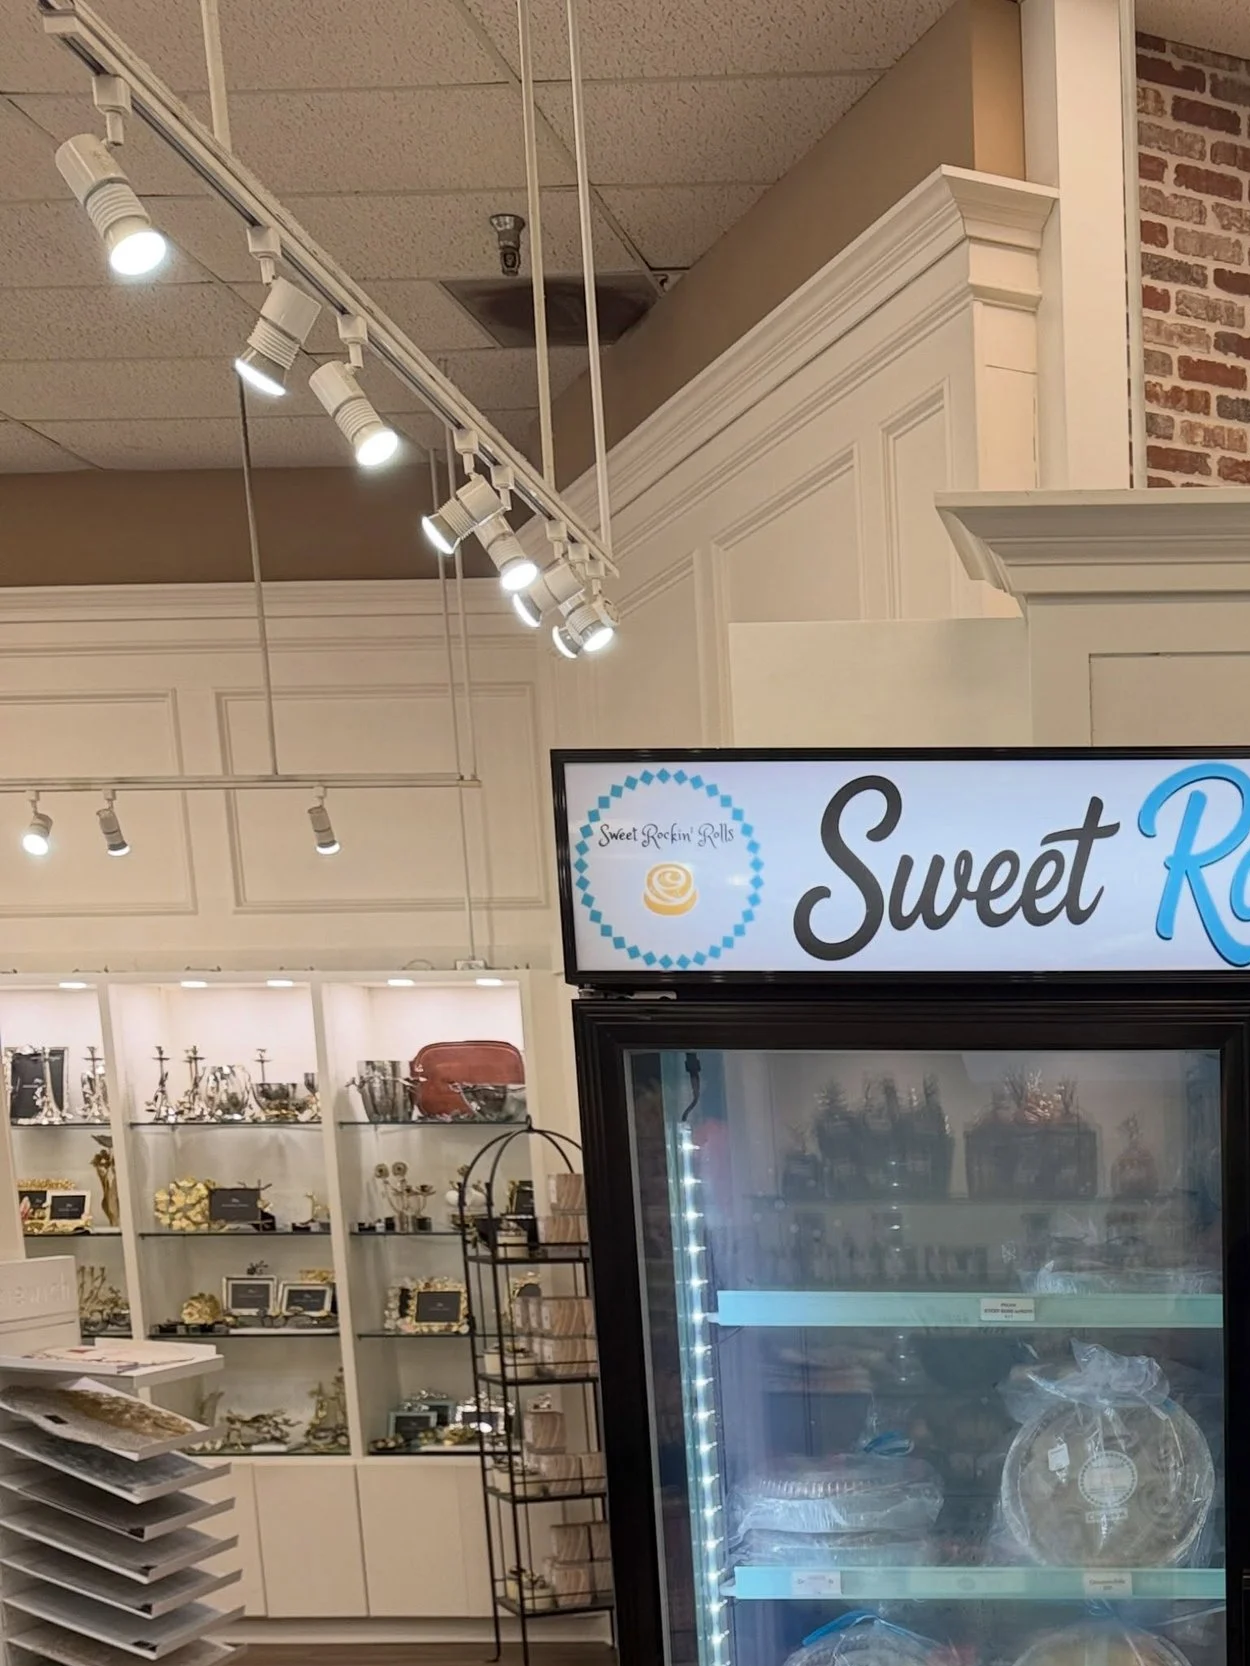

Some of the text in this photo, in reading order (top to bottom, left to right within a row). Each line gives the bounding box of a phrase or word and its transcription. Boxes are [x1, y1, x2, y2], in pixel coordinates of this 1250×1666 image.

[598, 823, 735, 849] Sweet Rockin' Rolls
[793, 774, 1120, 961] Sweet
